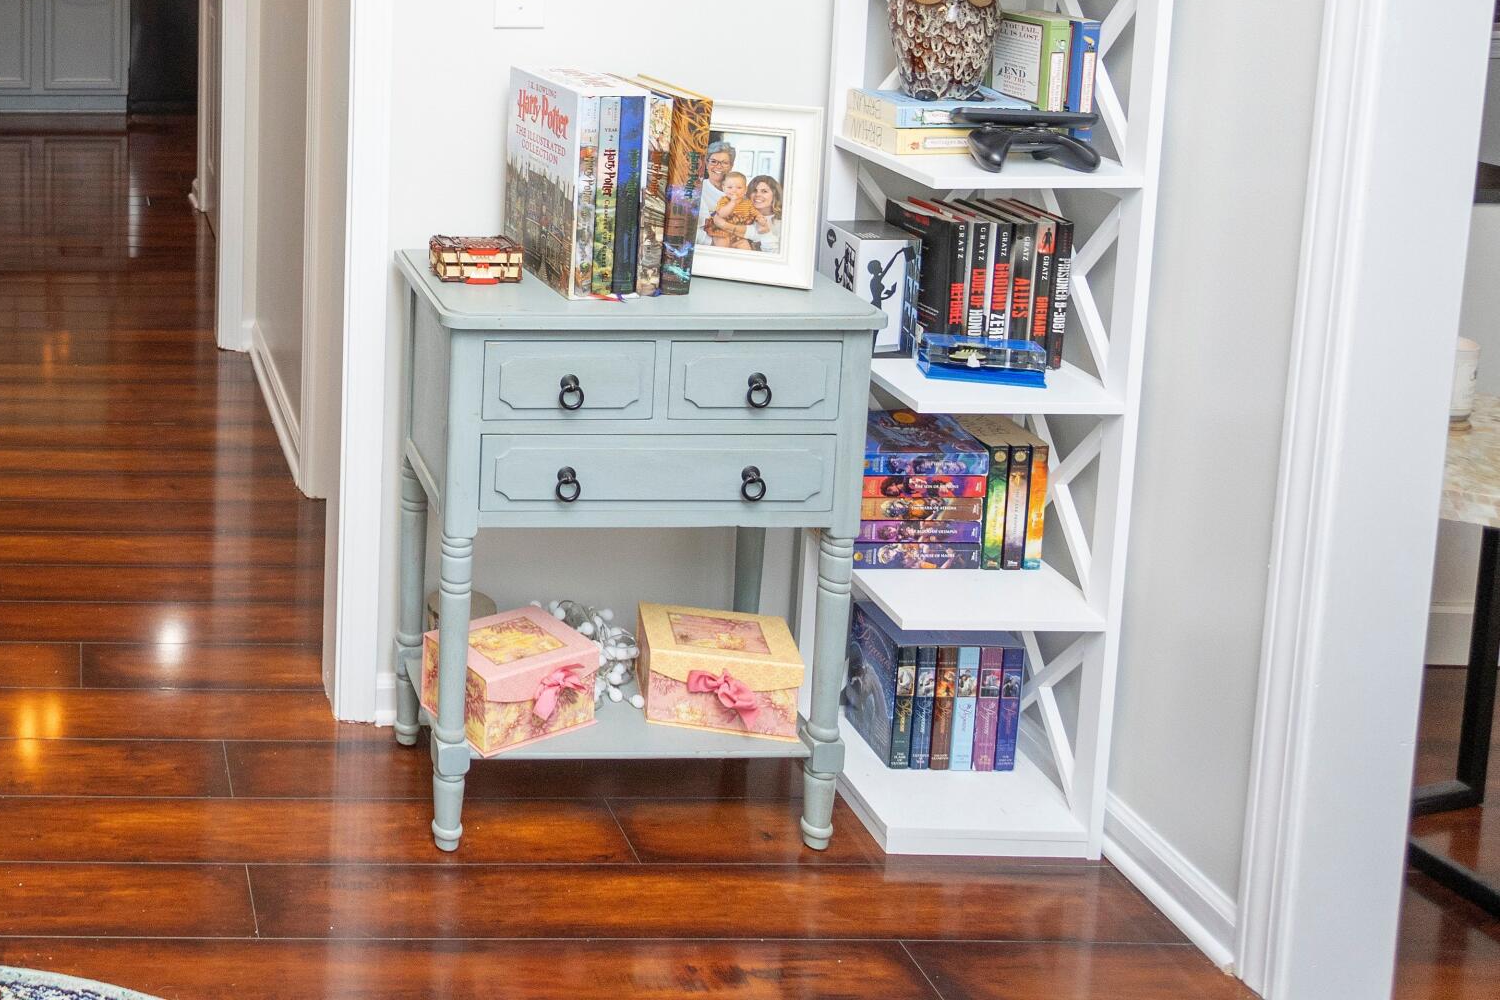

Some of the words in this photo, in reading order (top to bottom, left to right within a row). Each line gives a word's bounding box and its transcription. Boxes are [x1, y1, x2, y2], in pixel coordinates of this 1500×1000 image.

[1004, 21, 1020, 30] YOU
[1004, 66, 1026, 78] END
[517, 88, 541, 123] Harry
[541, 94, 570, 140] Potter
[516, 124, 527, 137] THE
[527, 128, 566, 157] ILLUSTRATED
[521, 139, 559, 165] COLLECTION
[603, 149, 616, 171] Harry
[581, 178, 595, 205] Potter
[603, 171, 616, 197] Potter
[957, 225, 965, 259] GRATZ
[978, 227, 987, 261] GRATZ
[1000, 232, 1008, 257] GRATZ
[1022, 236, 1031, 262] GRATZ
[971, 268, 987, 294] CODE
[1041, 255, 1050, 281] GRATZ
[1054, 257, 1072, 301] PRISONER
[991, 263, 1010, 311] GROUND
[1011, 277, 1031, 318] ALLIES
[948, 282, 965, 325] REFUGEE
[970, 295, 985, 308] OF
[967, 309, 984, 336] HONO
[1033, 296, 1049, 337] GRENADE
[1051, 301, 1067, 334] B-3087
